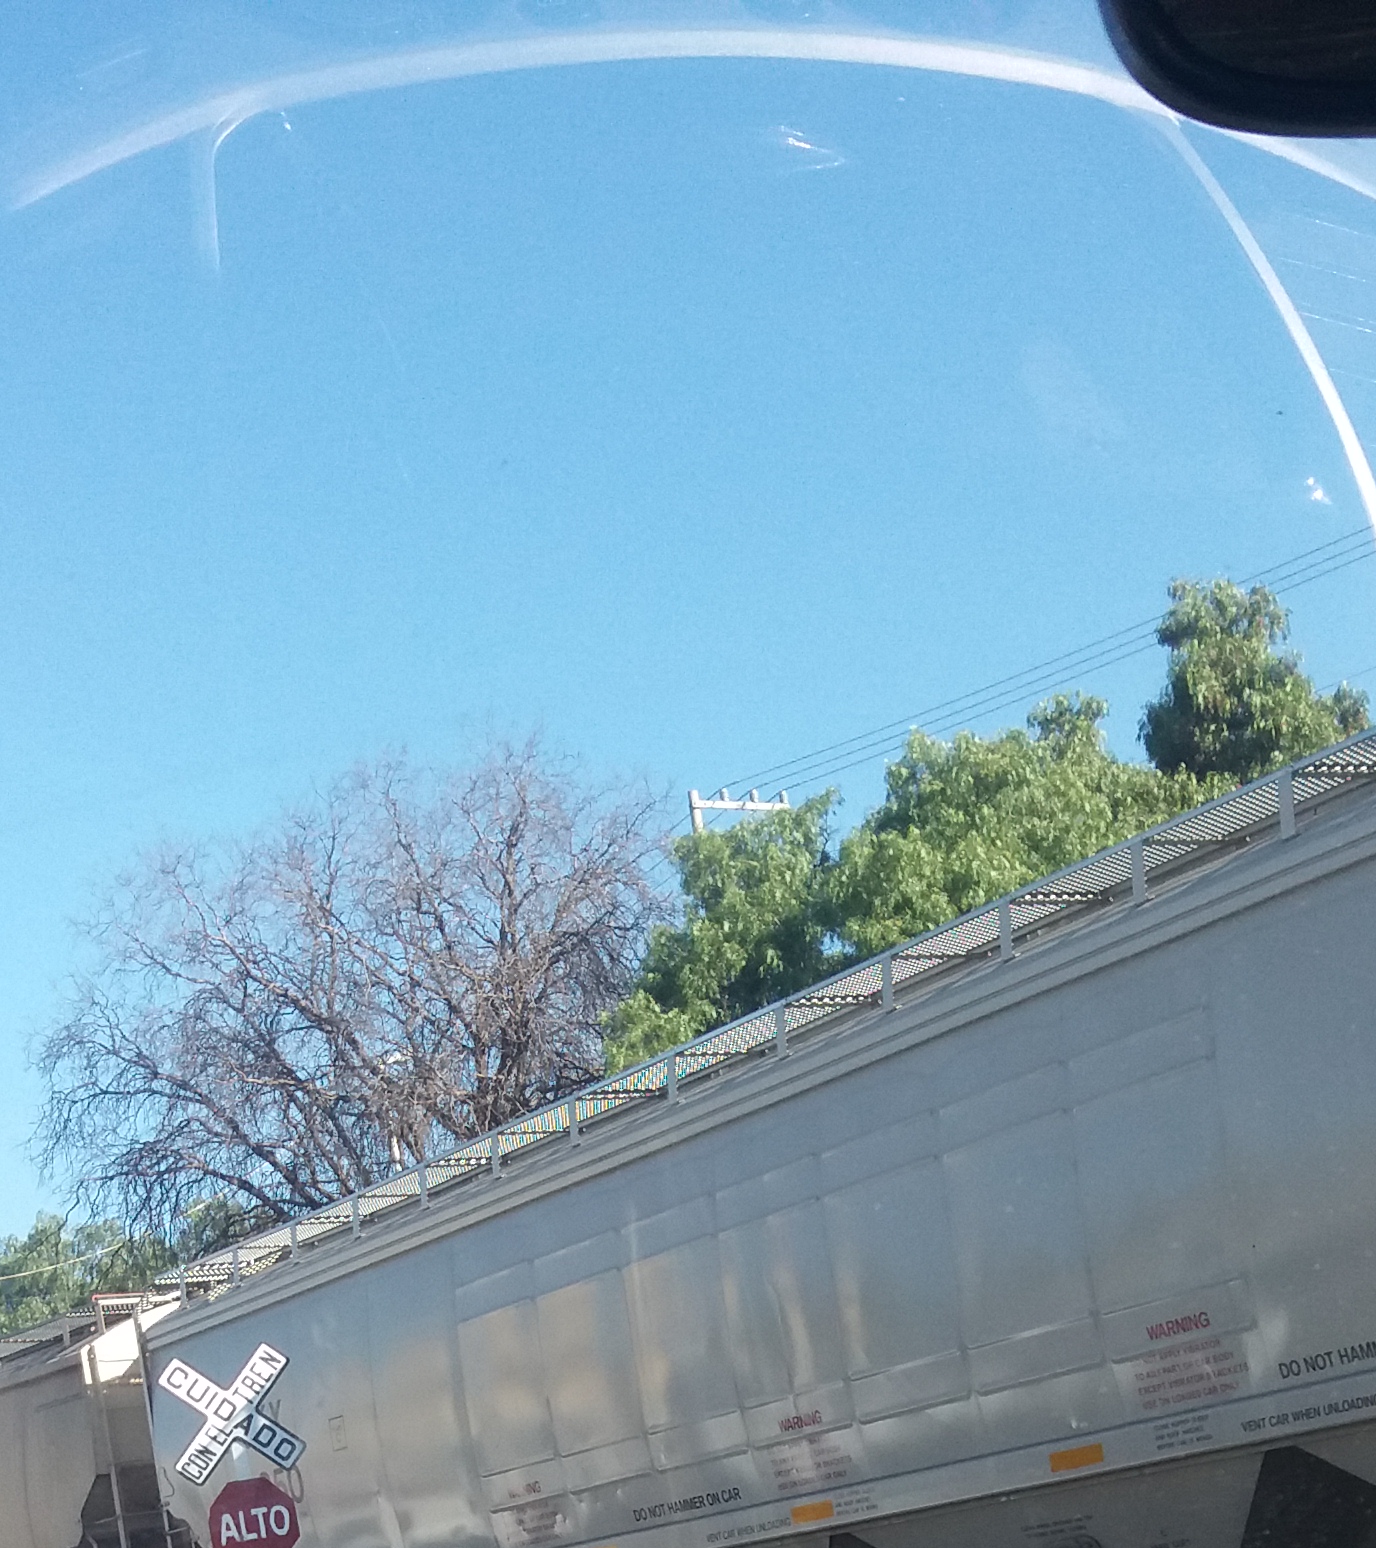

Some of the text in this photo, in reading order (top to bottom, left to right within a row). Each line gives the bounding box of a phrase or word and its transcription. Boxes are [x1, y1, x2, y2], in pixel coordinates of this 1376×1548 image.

[1146, 1311, 1211, 1340] WARNING
[1278, 1359, 1301, 1380] DO
[1303, 1350, 1335, 1375] NOT
[166, 1366, 297, 1462] CUIDADO
[181, 1350, 282, 1480] CON EL TREN
[1241, 1416, 1266, 1434] VENT
[1268, 1412, 1290, 1428] CAR
[1291, 1405, 1321, 1424] WHEN
[633, 1487, 742, 1522] DO NOT HAMMER ON CAR
[220, 1505, 290, 1546] ALTO
